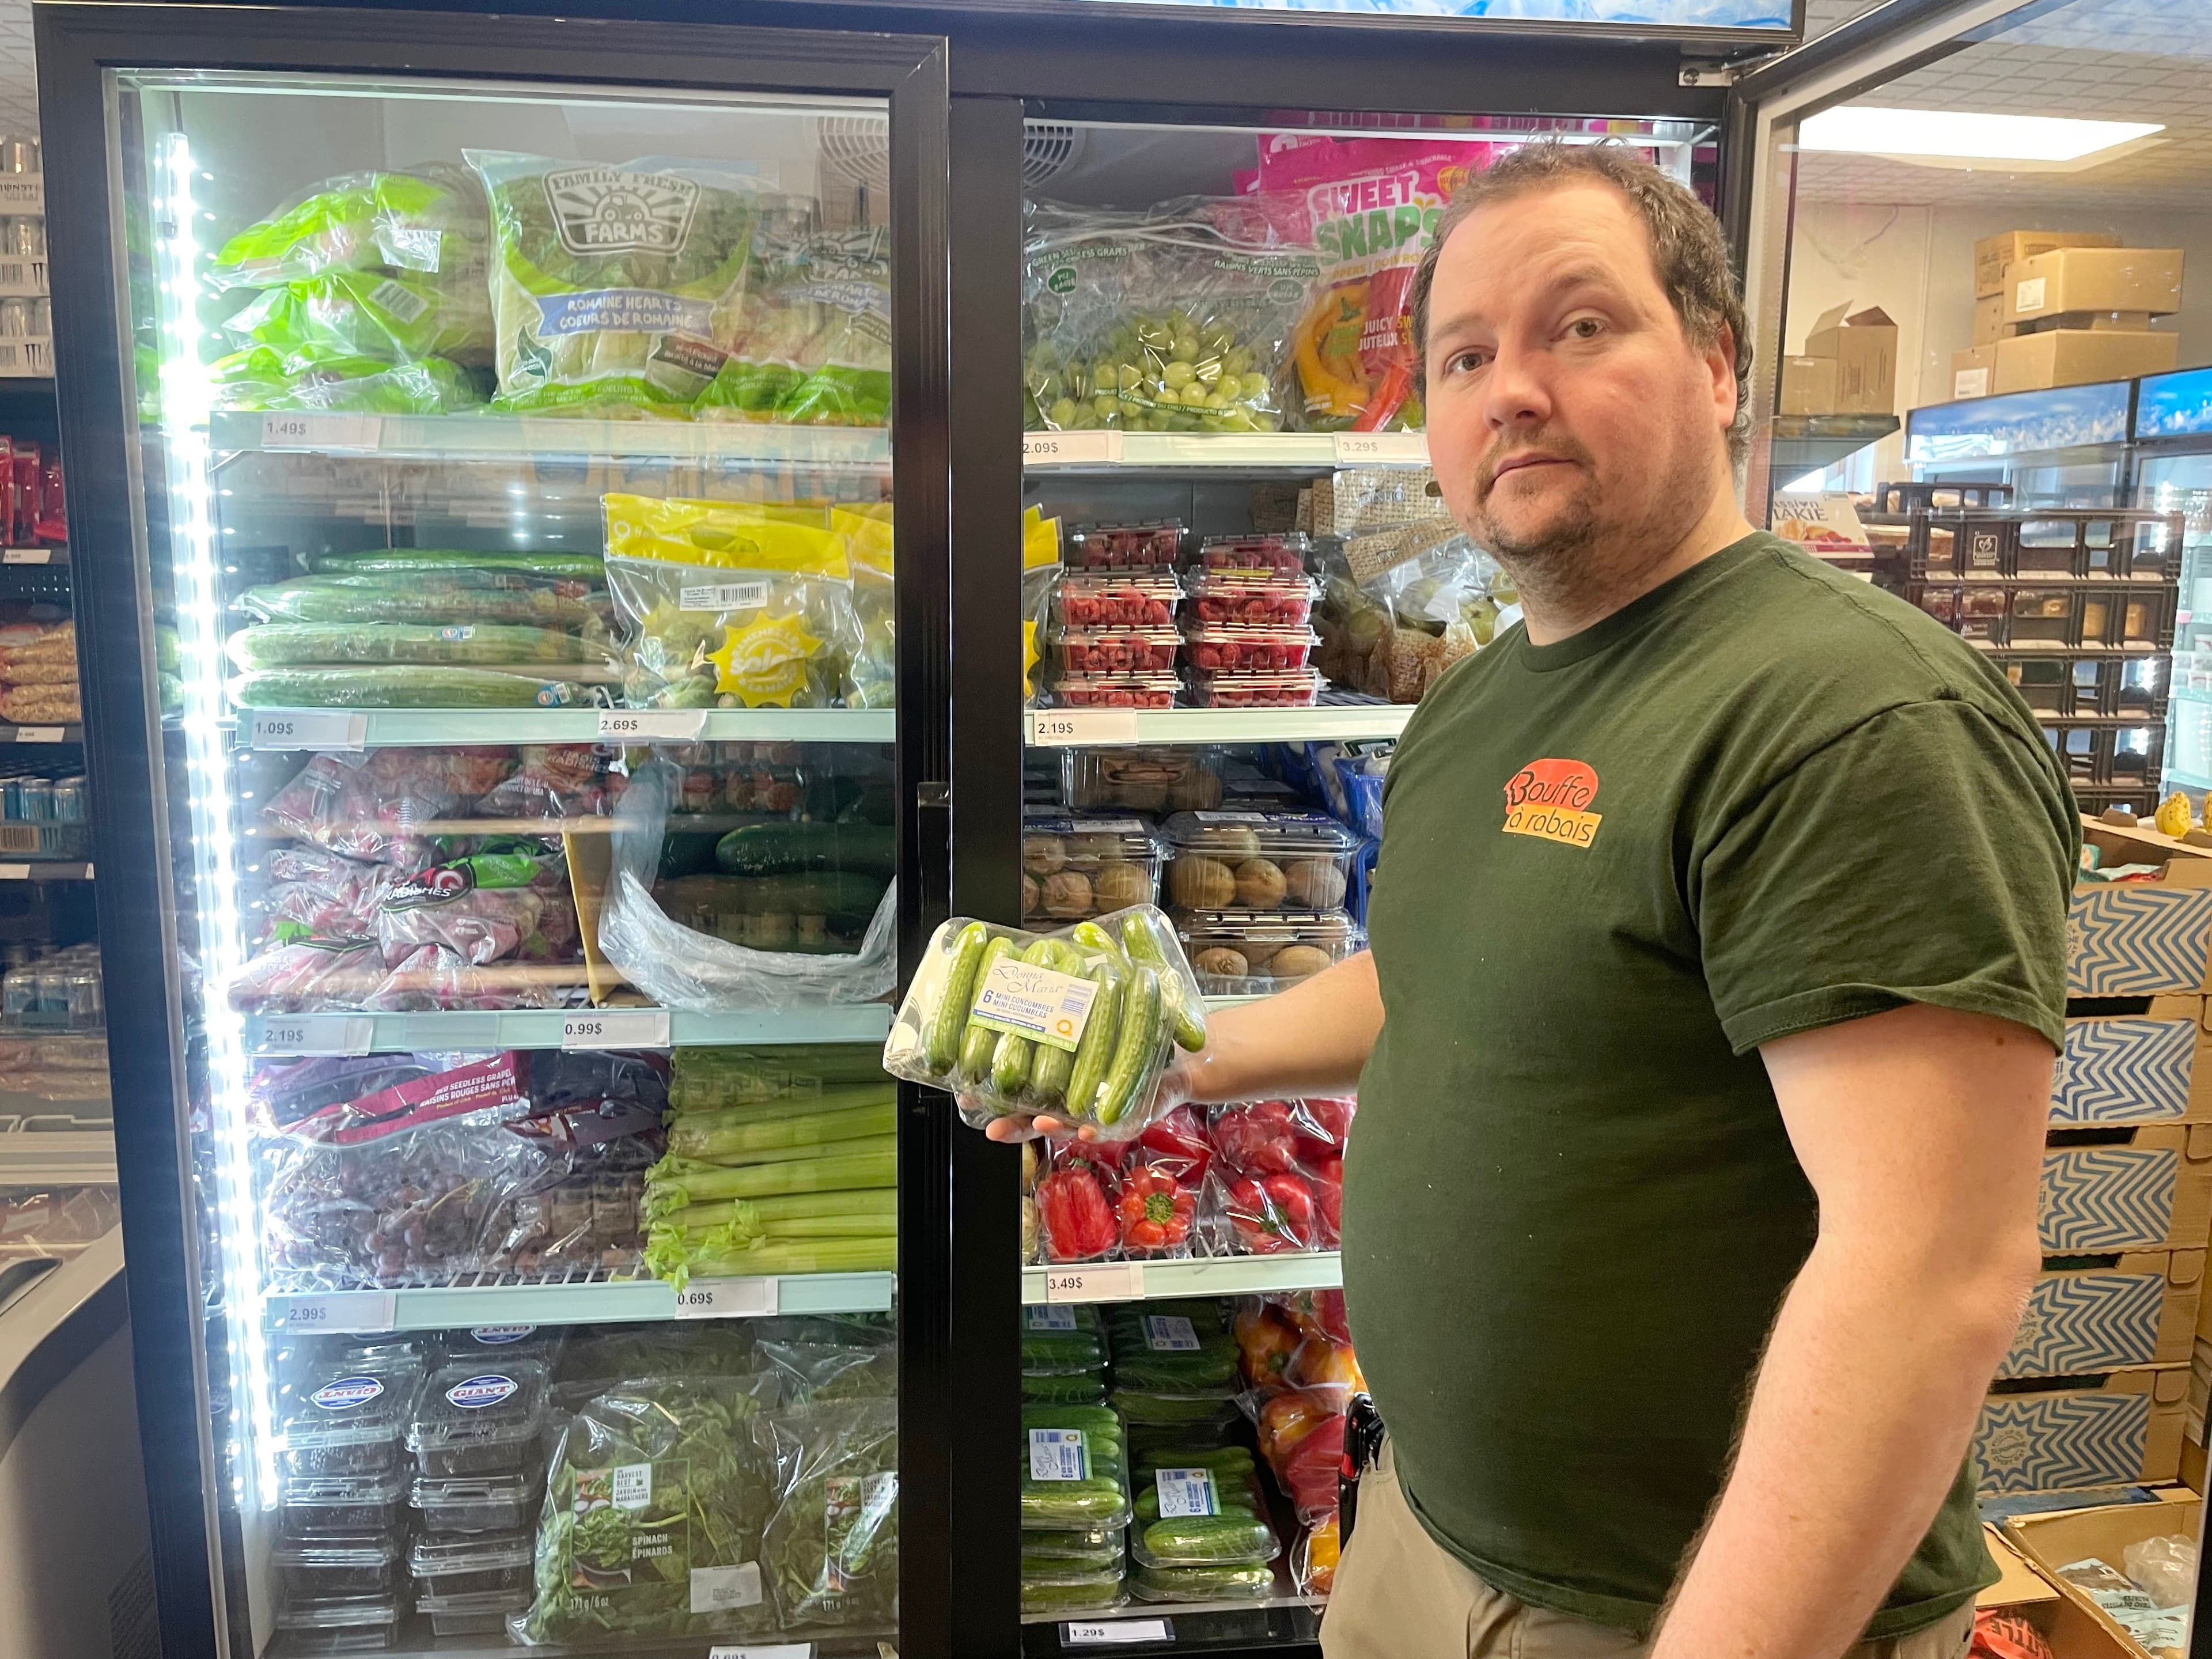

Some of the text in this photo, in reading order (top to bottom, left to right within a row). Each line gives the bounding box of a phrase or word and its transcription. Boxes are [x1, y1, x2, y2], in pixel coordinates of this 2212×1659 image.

[553, 172, 622, 190] FAMILY
[1312, 175, 1413, 214] SWEET
[584, 222, 663, 243] FARMS
[1316, 205, 1443, 265] SNAPS
[567, 295, 683, 312] ROMAINE HEARTS
[559, 313, 693, 329] COEURS DE ROMAINE
[1363, 316, 1393, 335] JUICY
[1358, 332, 1399, 352] JUTEUX
[267, 422, 306, 435] 1.49$
[1023, 442, 1059, 454] 2.09$
[1343, 442, 1378, 452] 3.29$
[1772, 507, 1829, 521] LAKIE
[255, 721, 294, 735] 1.09$
[600, 719, 638, 730] 2.69$
[1038, 722, 1074, 734] 2.19$
[1510, 771, 1590, 808] Bouffe
[1509, 806, 1594, 842] à rabais
[993, 965, 1044, 979] Donna
[1007, 979, 1060, 994] Maria
[983, 990, 1055, 1013] 6 MINI CONCOMBRES
[993, 999, 1008, 1008] MINI
[1009, 1003, 1048, 1018] CUCUMBERS
[565, 1022, 603, 1035] 0.99$
[265, 1029, 304, 1043] 2.19$
[450, 1077, 486, 1090] SEEDLESS
[419, 1093, 449, 1108] RAISINS
[450, 1085, 479, 1100] ROUGES
[480, 1081, 501, 1093] SANS
[1049, 1277, 1083, 1289] 3.49$
[677, 1292, 713, 1305] 0.69$
[289, 1307, 327, 1321] 2.99$
[319, 1386, 377, 1399] GIANT
[453, 1384, 511, 1398] GIANT
[632, 1533, 668, 1546] SPINACH
[632, 1545, 673, 1559] ÉPINARDS
[1071, 1628, 1105, 1637] 1.29$
